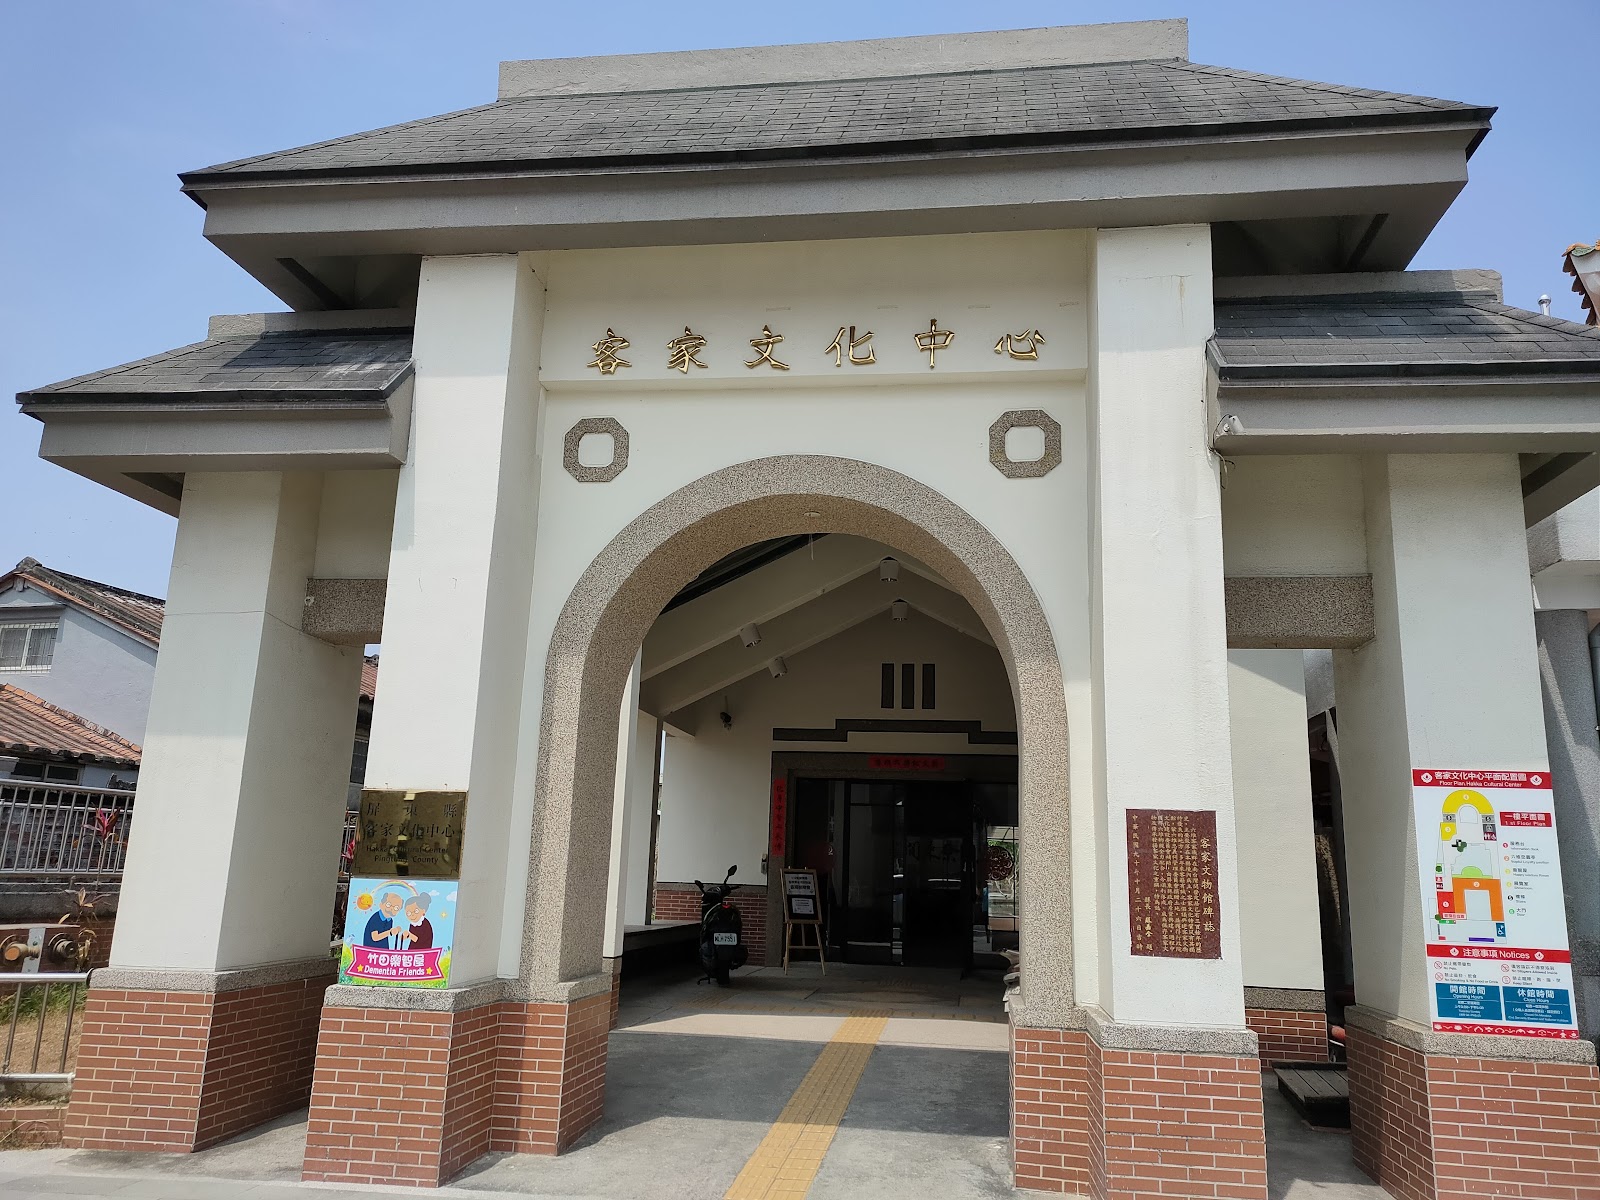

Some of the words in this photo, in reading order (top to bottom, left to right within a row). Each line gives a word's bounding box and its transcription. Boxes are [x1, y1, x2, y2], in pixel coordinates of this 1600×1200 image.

[587, 318, 1046, 375] 客家文化中心
[1434, 771, 1527, 782] 客家文化中心平面配置圖
[366, 823, 455, 838] 客家文化中心
[413, 856, 439, 865] County
[1463, 948, 1498, 958] 注意事項
[1499, 950, 1530, 960] Notices
[367, 953, 424, 967] 竹田樂智屋
[364, 965, 396, 975] Dementia
[398, 967, 425, 976] Friends
[1449, 985, 1486, 995] 開館時間
[1517, 988, 1554, 999] 休館時間
